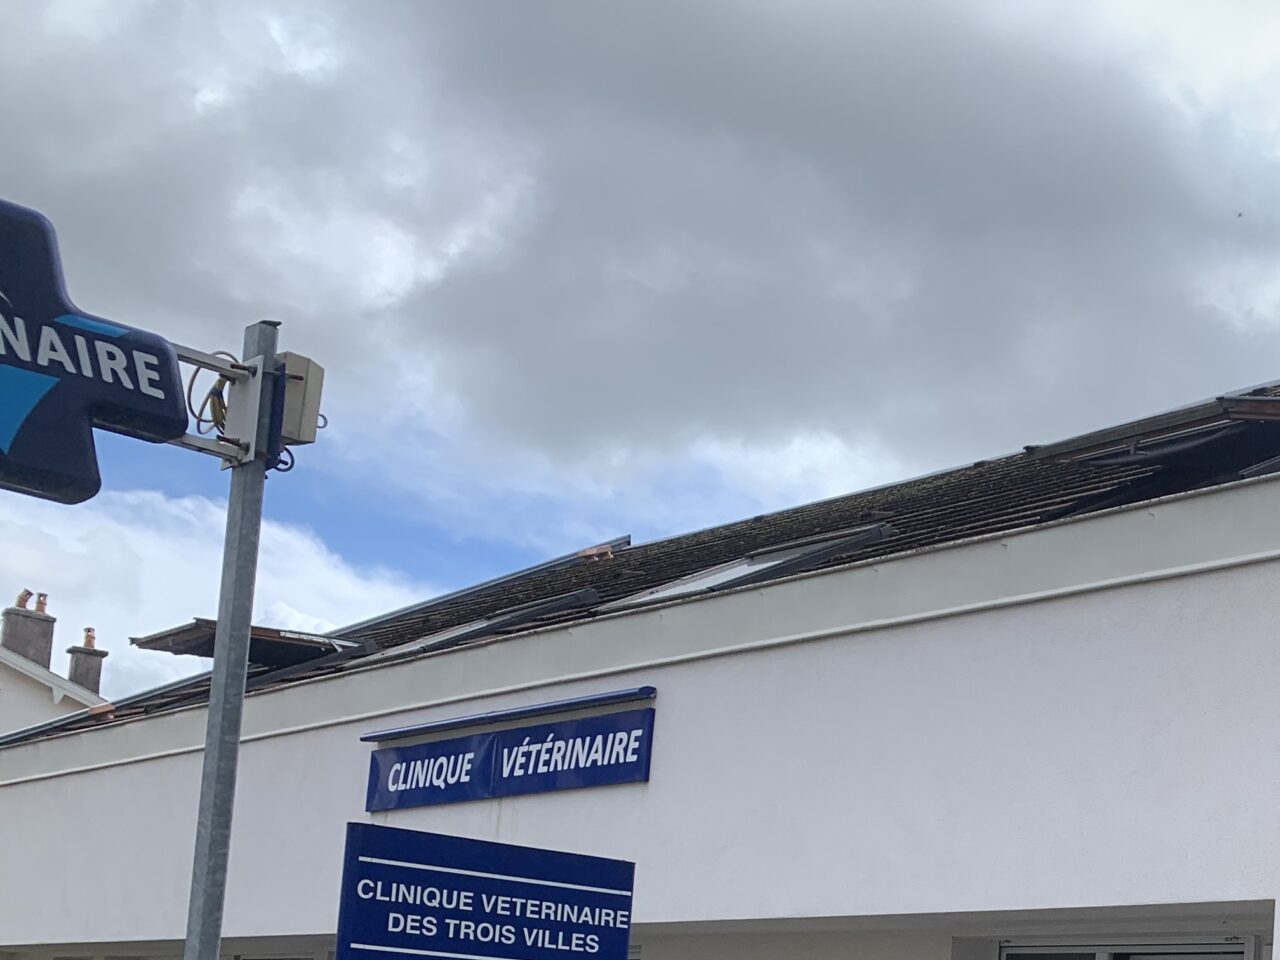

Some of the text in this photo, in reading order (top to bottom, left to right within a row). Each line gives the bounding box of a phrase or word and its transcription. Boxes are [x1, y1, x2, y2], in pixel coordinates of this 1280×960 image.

[387, 728, 643, 792] CLINIQUE VÉTÉRINAIRE
[356, 878, 629, 929] CLINIQUE VETERINAIRE
[387, 912, 600, 954] DES TROIS VILLES
